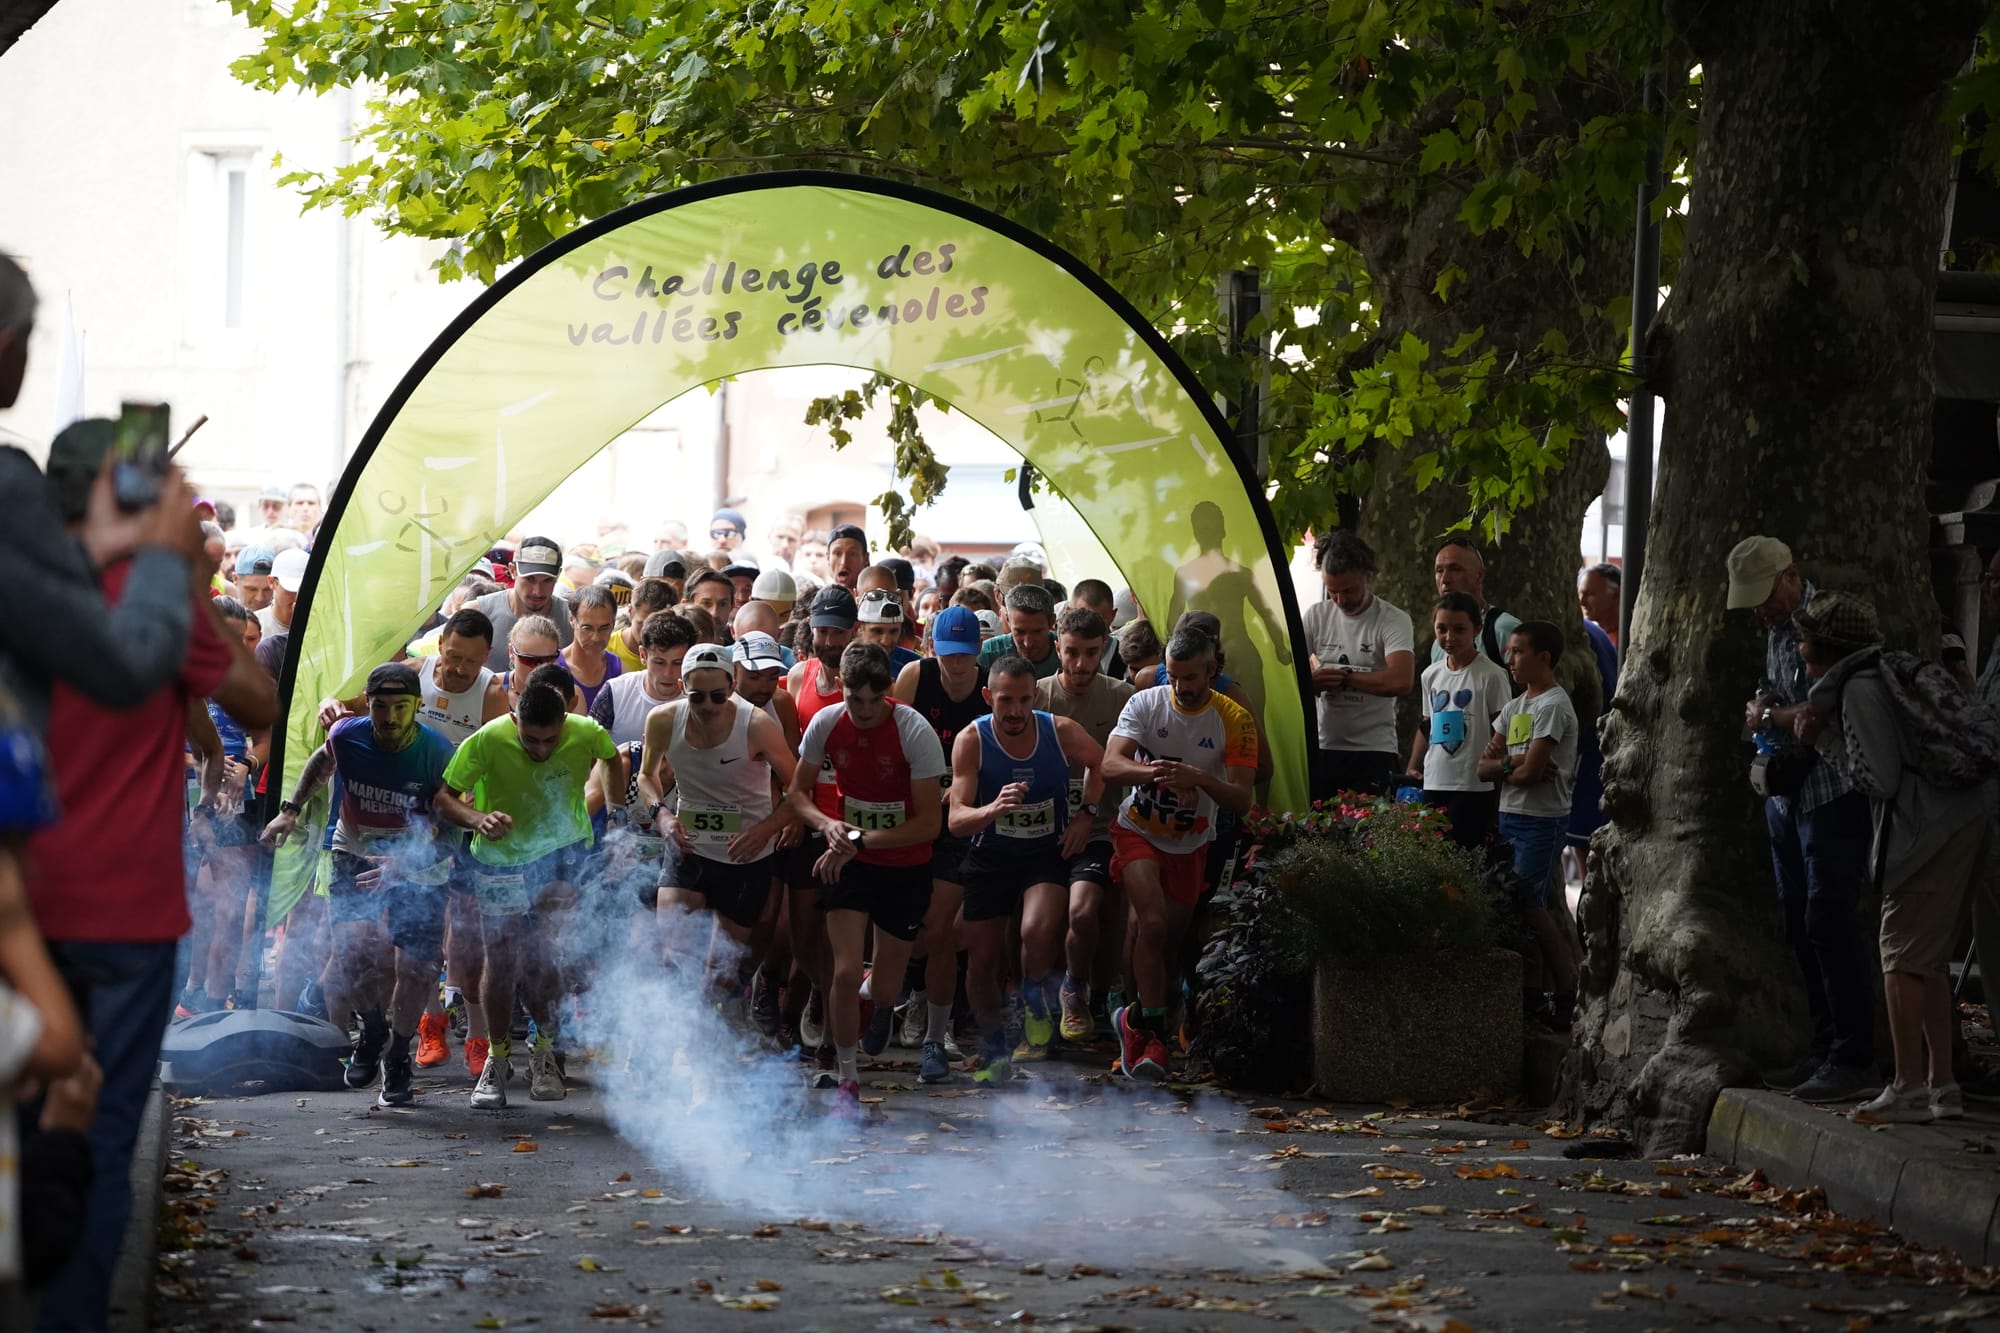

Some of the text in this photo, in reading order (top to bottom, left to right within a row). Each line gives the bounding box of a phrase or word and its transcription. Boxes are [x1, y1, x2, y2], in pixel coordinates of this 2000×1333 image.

[592, 243, 957, 302] Challenge des
[567, 284, 989, 347] vallées cévenoles
[1442, 723, 1451, 735] 5
[694, 813, 724, 831] 53
[852, 811, 897, 830] 113
[1004, 810, 1047, 828] 134
